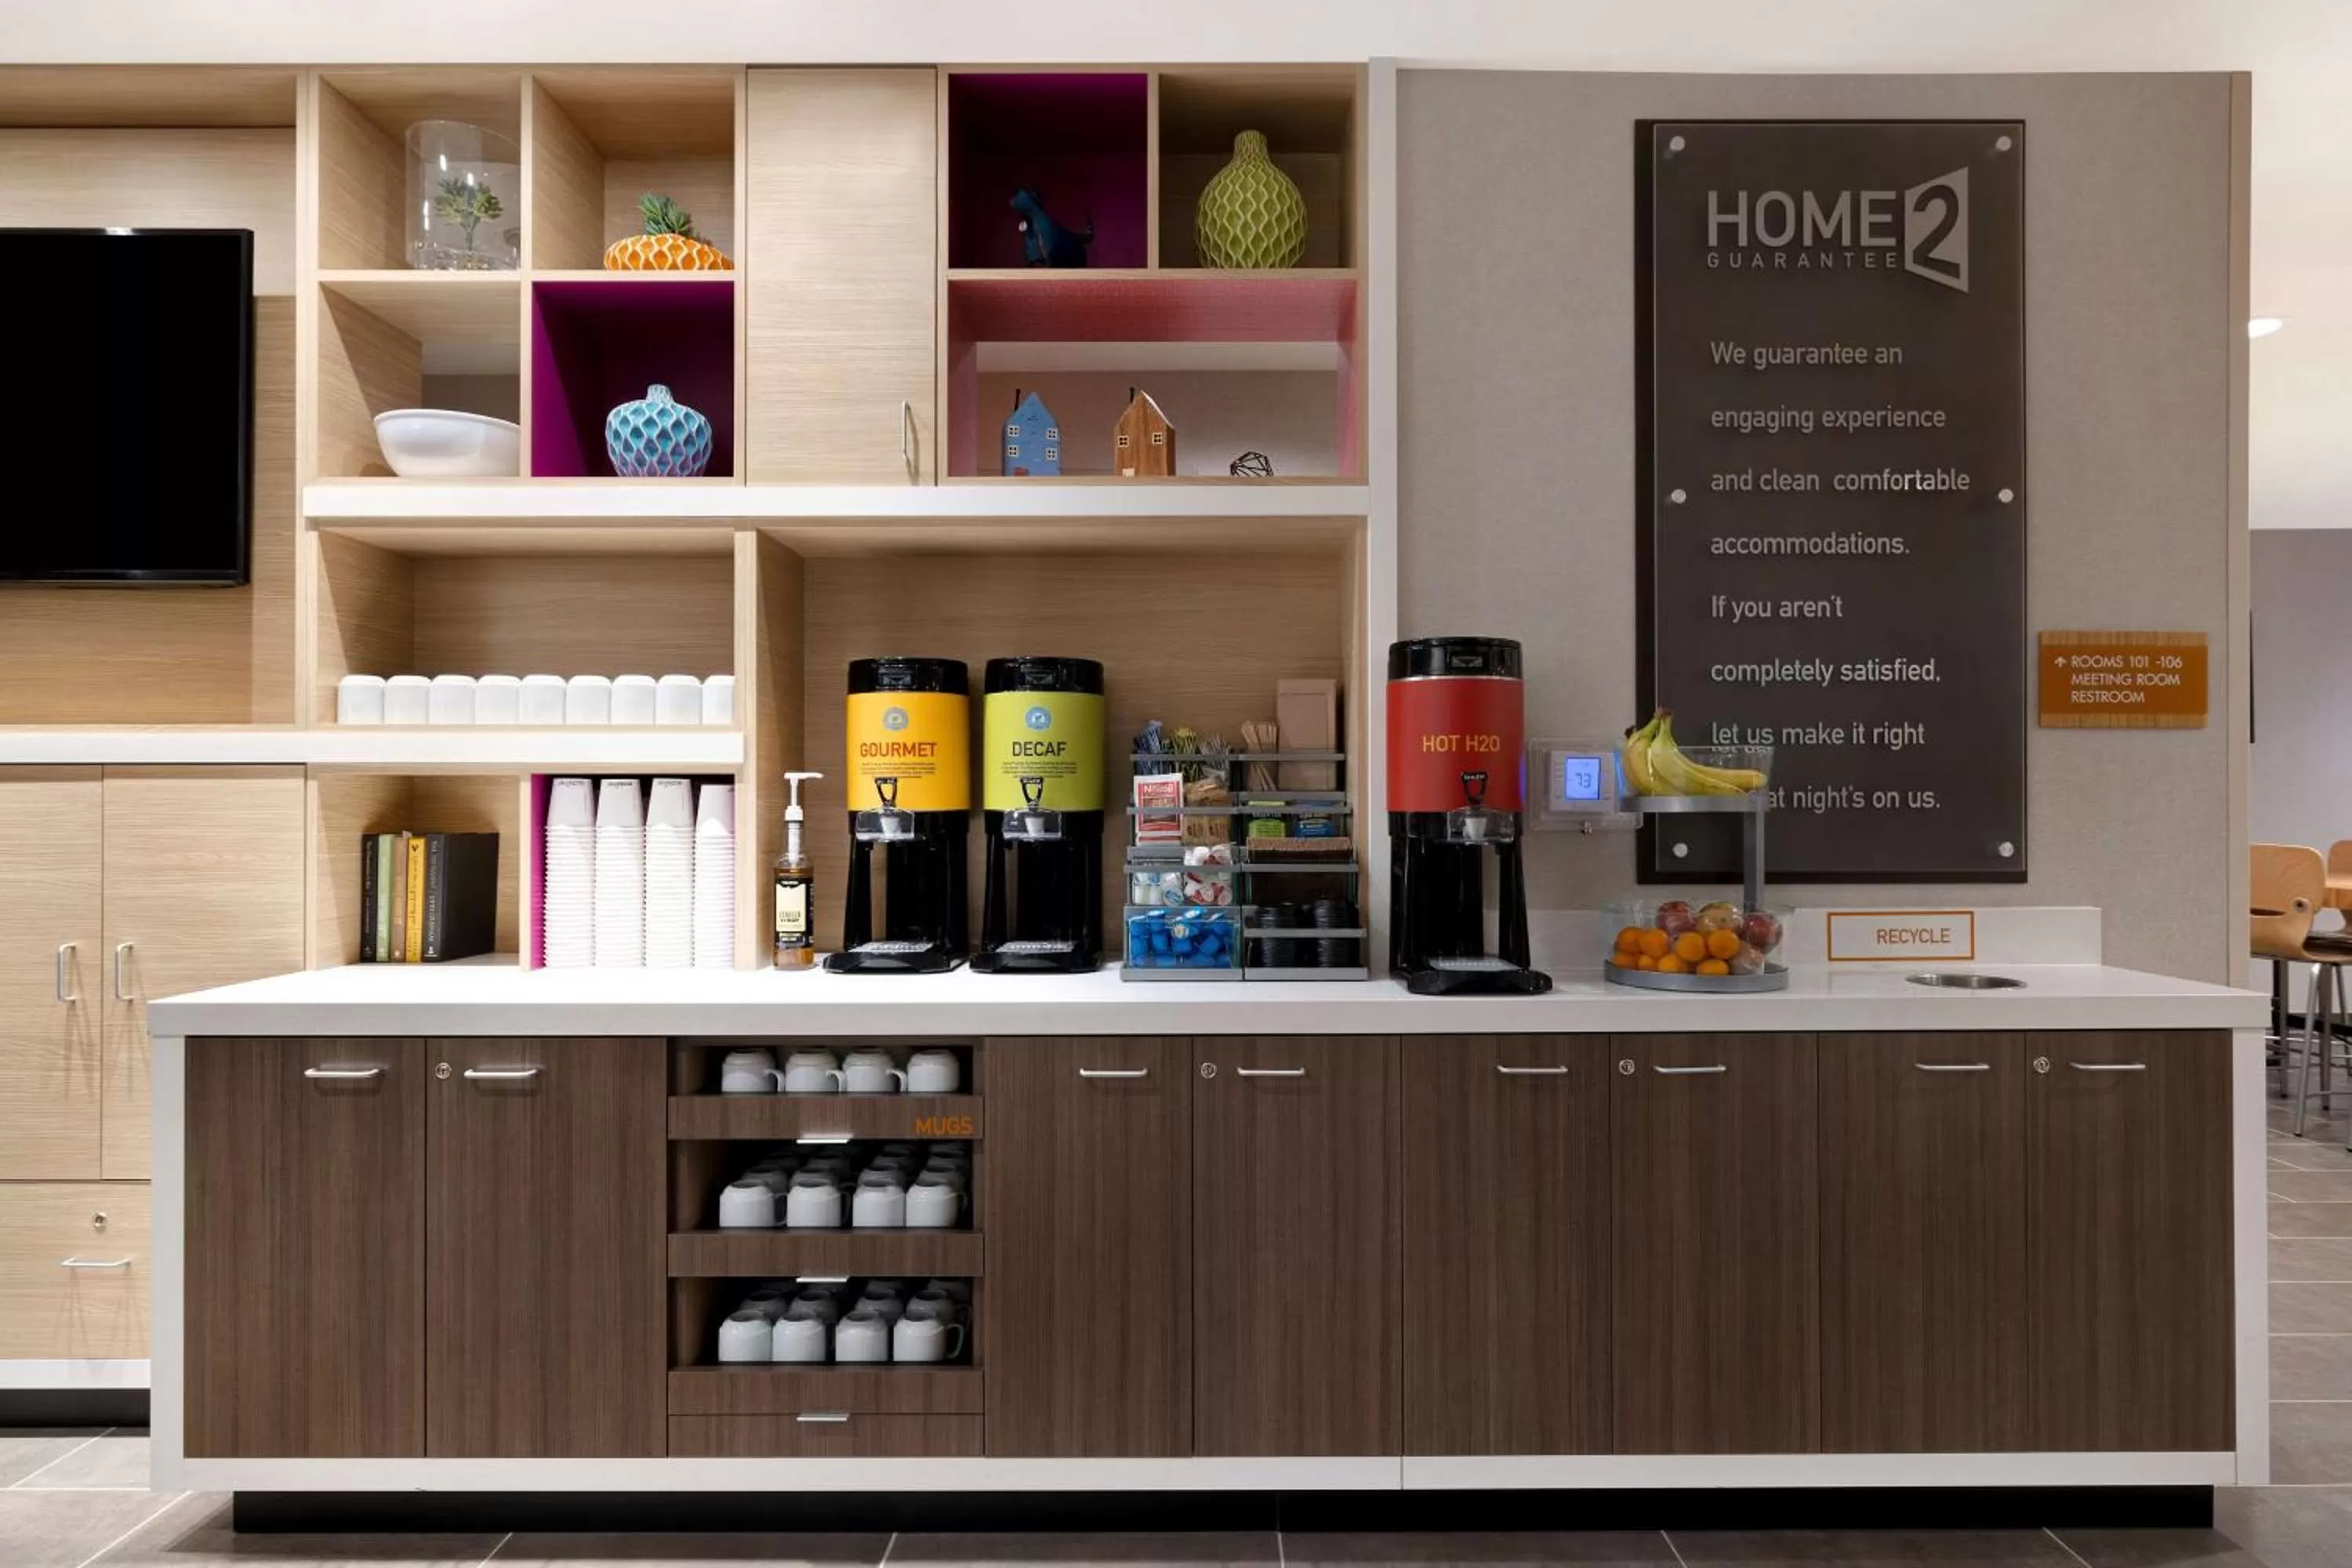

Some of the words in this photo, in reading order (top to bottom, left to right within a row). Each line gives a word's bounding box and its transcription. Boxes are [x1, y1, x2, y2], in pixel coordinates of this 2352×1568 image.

[1708, 191, 1896, 247] HOME
[1708, 252, 1896, 269] GUARANTEE
[1711, 341, 1746, 365] We
[1754, 342, 1868, 370] guarantee
[1875, 347, 1903, 365] an
[1711, 405, 1814, 434] engaging
[1822, 405, 1946, 434] experience
[1711, 469, 1752, 491] and
[1759, 469, 1820, 491] clean
[1833, 469, 1970, 491] comfortable
[1711, 532, 1910, 554] accommodations.
[1711, 596, 1726, 618] If
[1732, 601, 1772, 624] you
[1779, 596, 1843, 618] aren't
[2071, 655, 2124, 669] ROOMS
[2130, 655, 2149, 668] 101
[1711, 659, 1834, 688] completely
[2071, 673, 2132, 686] MEETING
[2136, 673, 2180, 686] ROOM
[2071, 690, 2146, 703] RESTROOM
[1422, 735, 1461, 753] HOT
[1712, 722, 1739, 744] let
[1748, 728, 1774, 744] us
[1782, 722, 1845, 745] make
[1853, 722, 1866, 745] it
[1873, 722, 1925, 750] right
[860, 742, 938, 757] GOURMET
[1012, 741, 1067, 757] DECAF
[1793, 785, 1865, 815] night's
[1872, 791, 1900, 809] on
[1907, 791, 1941, 809] us.
[1876, 927, 1951, 945] RECYCLE
[916, 1116, 973, 1135] MUGS
